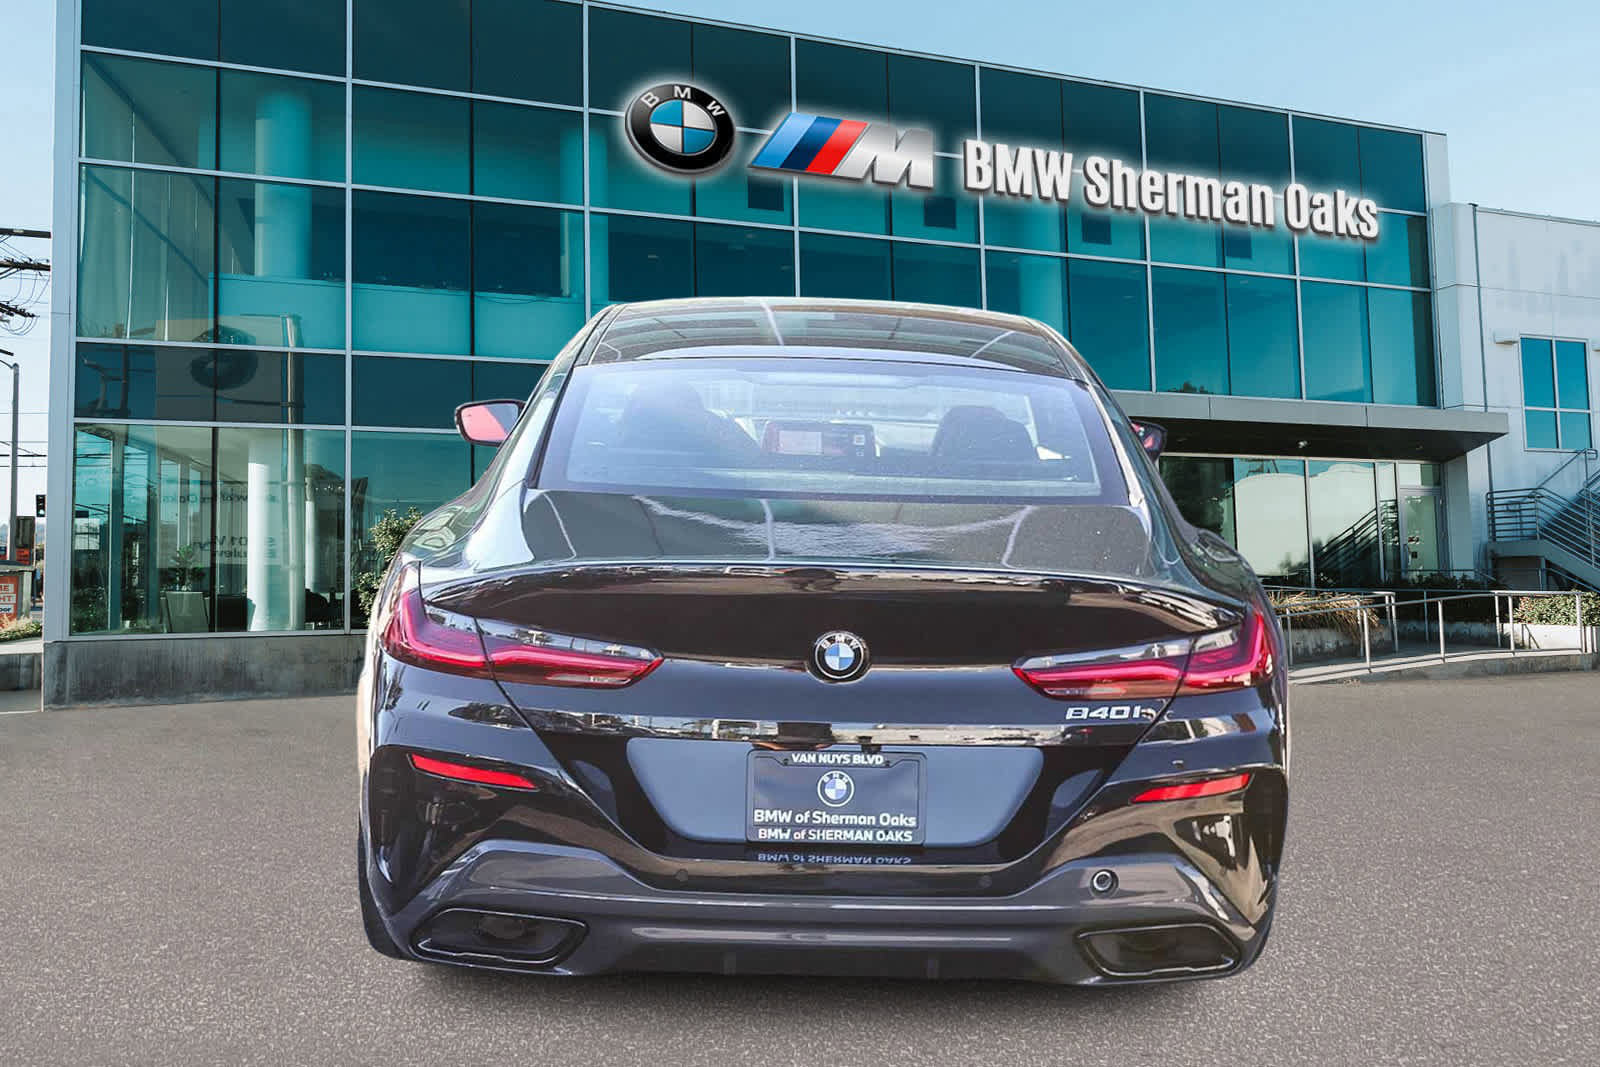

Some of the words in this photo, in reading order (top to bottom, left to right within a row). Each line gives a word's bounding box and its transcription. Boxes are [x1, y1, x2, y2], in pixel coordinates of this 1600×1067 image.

[641, 85, 726, 117] BMW
[963, 138, 1073, 202] BMW
[1083, 157, 1275, 227] Sherman
[1284, 182, 1380, 241] Oaks
[791, 753, 818, 763] VAN
[818, 754, 850, 764] NUYS
[852, 754, 884, 765] BLVD
[754, 809, 793, 823] BMW
[795, 811, 811, 823] of
[812, 812, 876, 825] Sherman
[879, 813, 917, 827] Oaks
[758, 829, 791, 840] BMW
[793, 829, 807, 840] of
[808, 830, 873, 841] SHERMAN
[876, 830, 913, 842] OAKS
